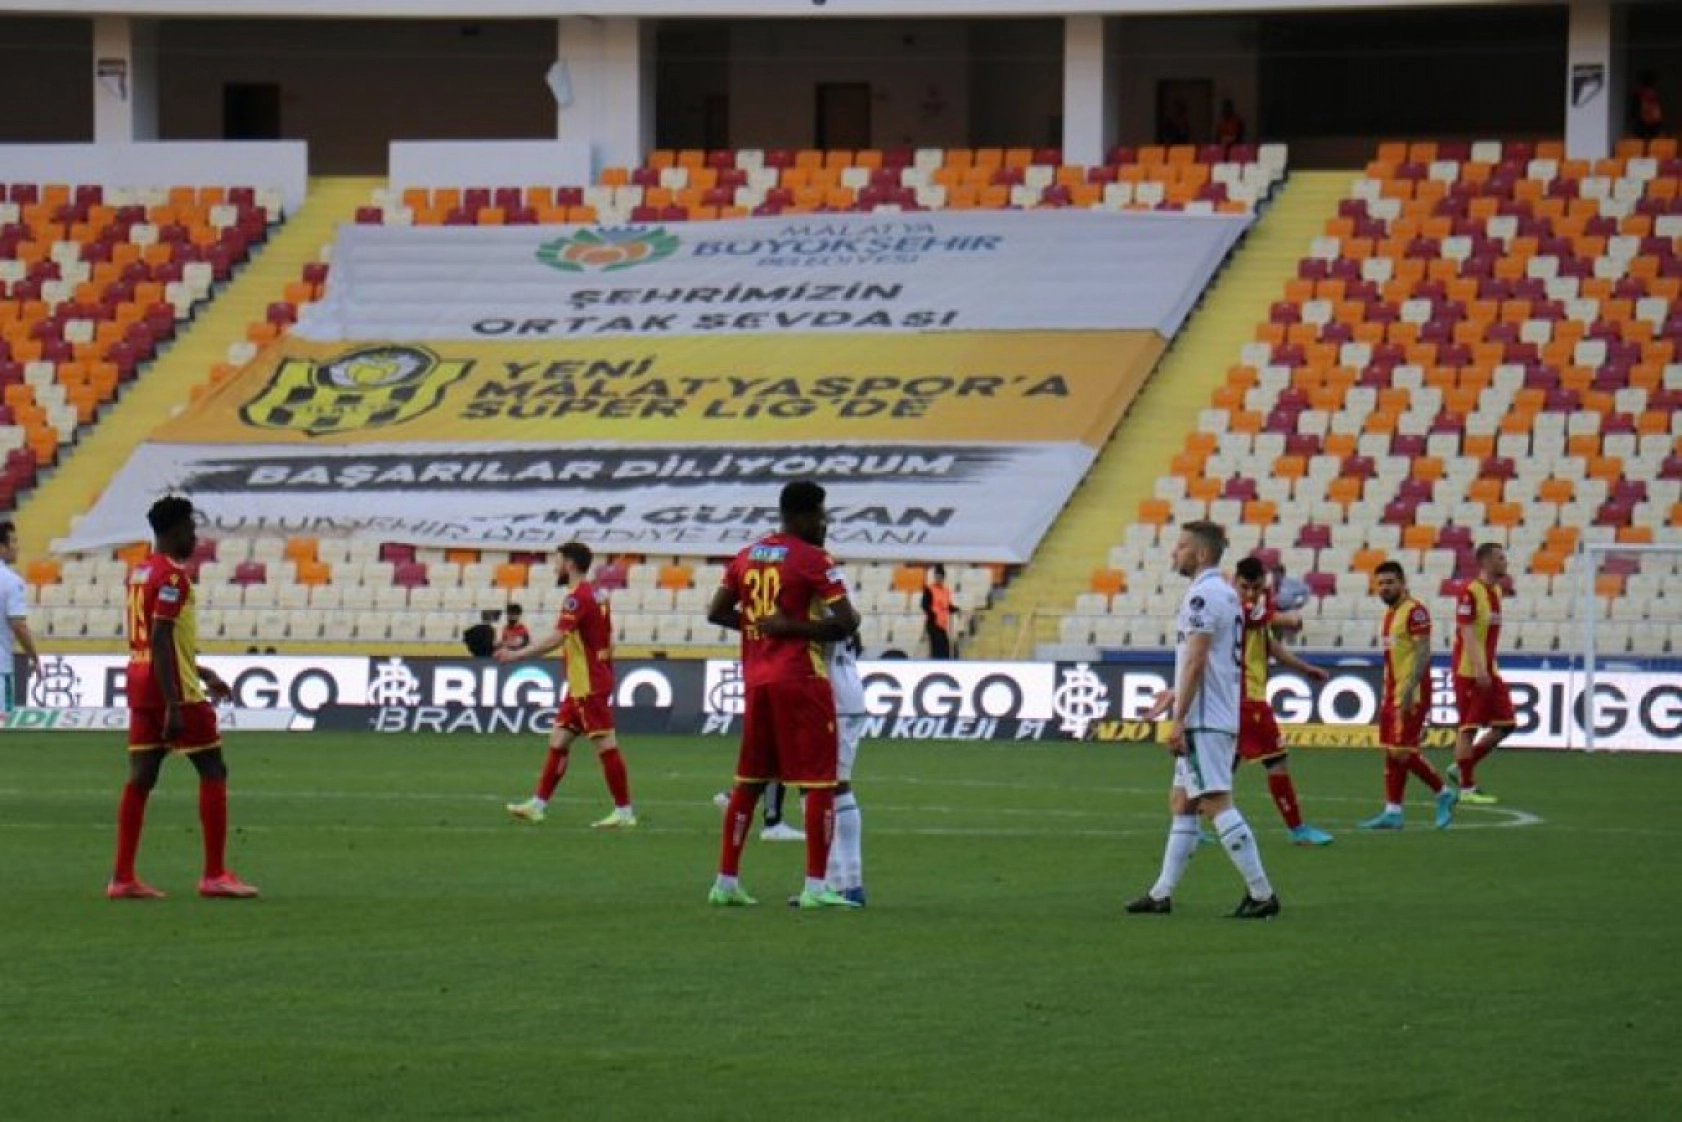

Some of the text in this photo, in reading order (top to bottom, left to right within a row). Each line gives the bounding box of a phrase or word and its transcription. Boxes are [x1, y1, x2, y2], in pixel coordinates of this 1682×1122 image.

[471, 309, 959, 335] ORTAK SEVDASI
[475, 375, 1070, 400] MALATYASPOR'A
[247, 459, 603, 488] BAŞARILAR
[743, 567, 781, 623] 30
[433, 665, 673, 707] BIGO
